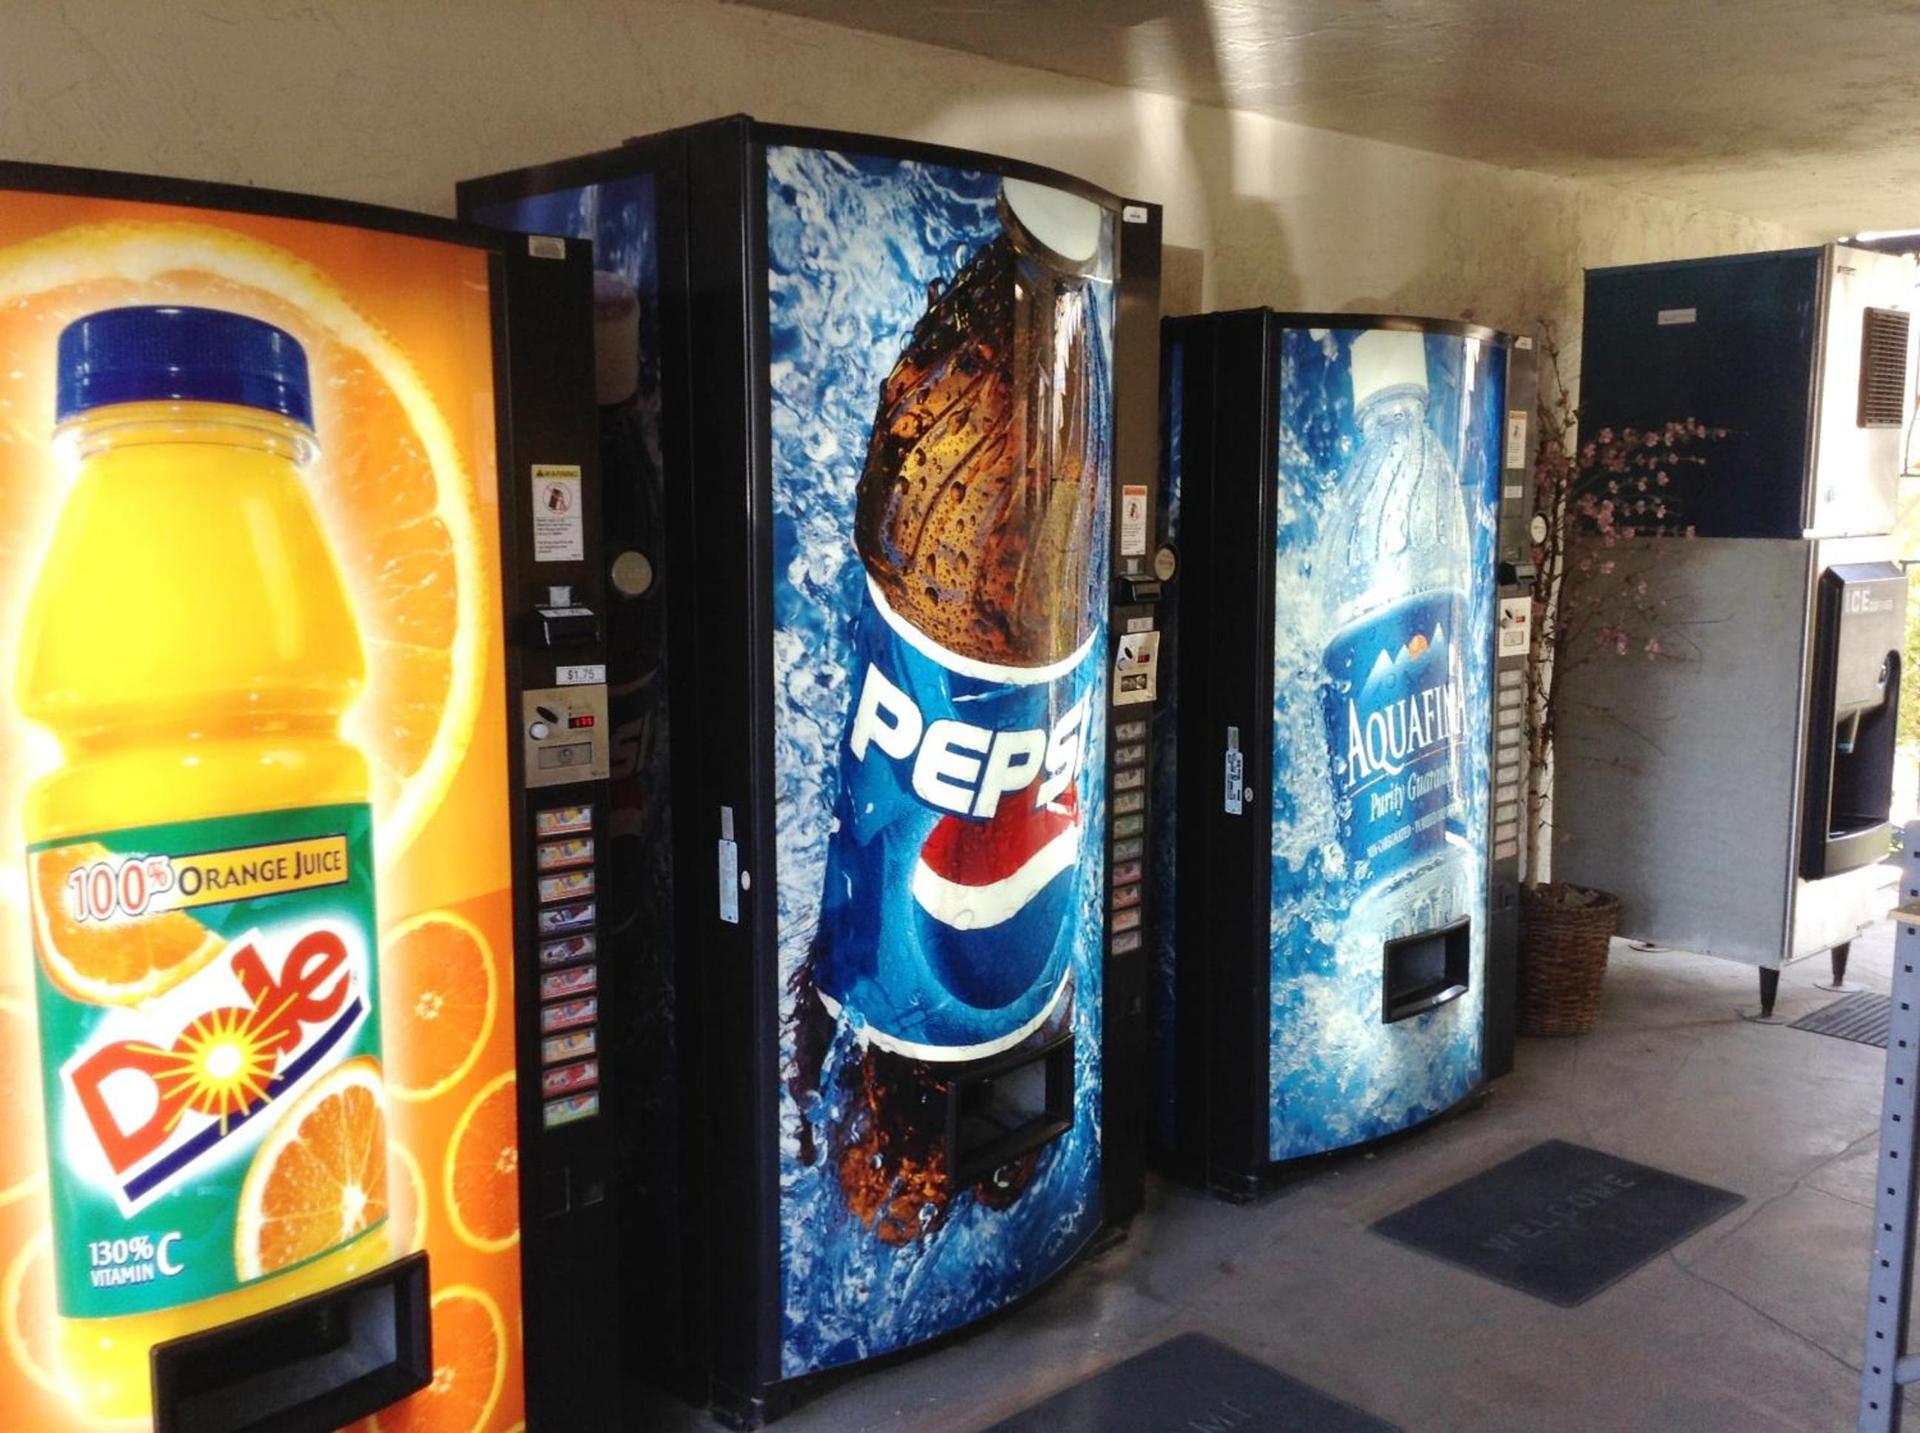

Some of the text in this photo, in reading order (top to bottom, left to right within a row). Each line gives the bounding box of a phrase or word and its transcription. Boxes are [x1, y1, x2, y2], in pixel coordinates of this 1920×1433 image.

[850, 662, 1092, 819] PEPSI
[1369, 783, 1405, 822] Purity
[69, 856, 174, 921] 100%
[71, 930, 351, 1175] Dole
[88, 1235, 154, 1267] 130%
[90, 1231, 185, 1287] VITAMIN C
